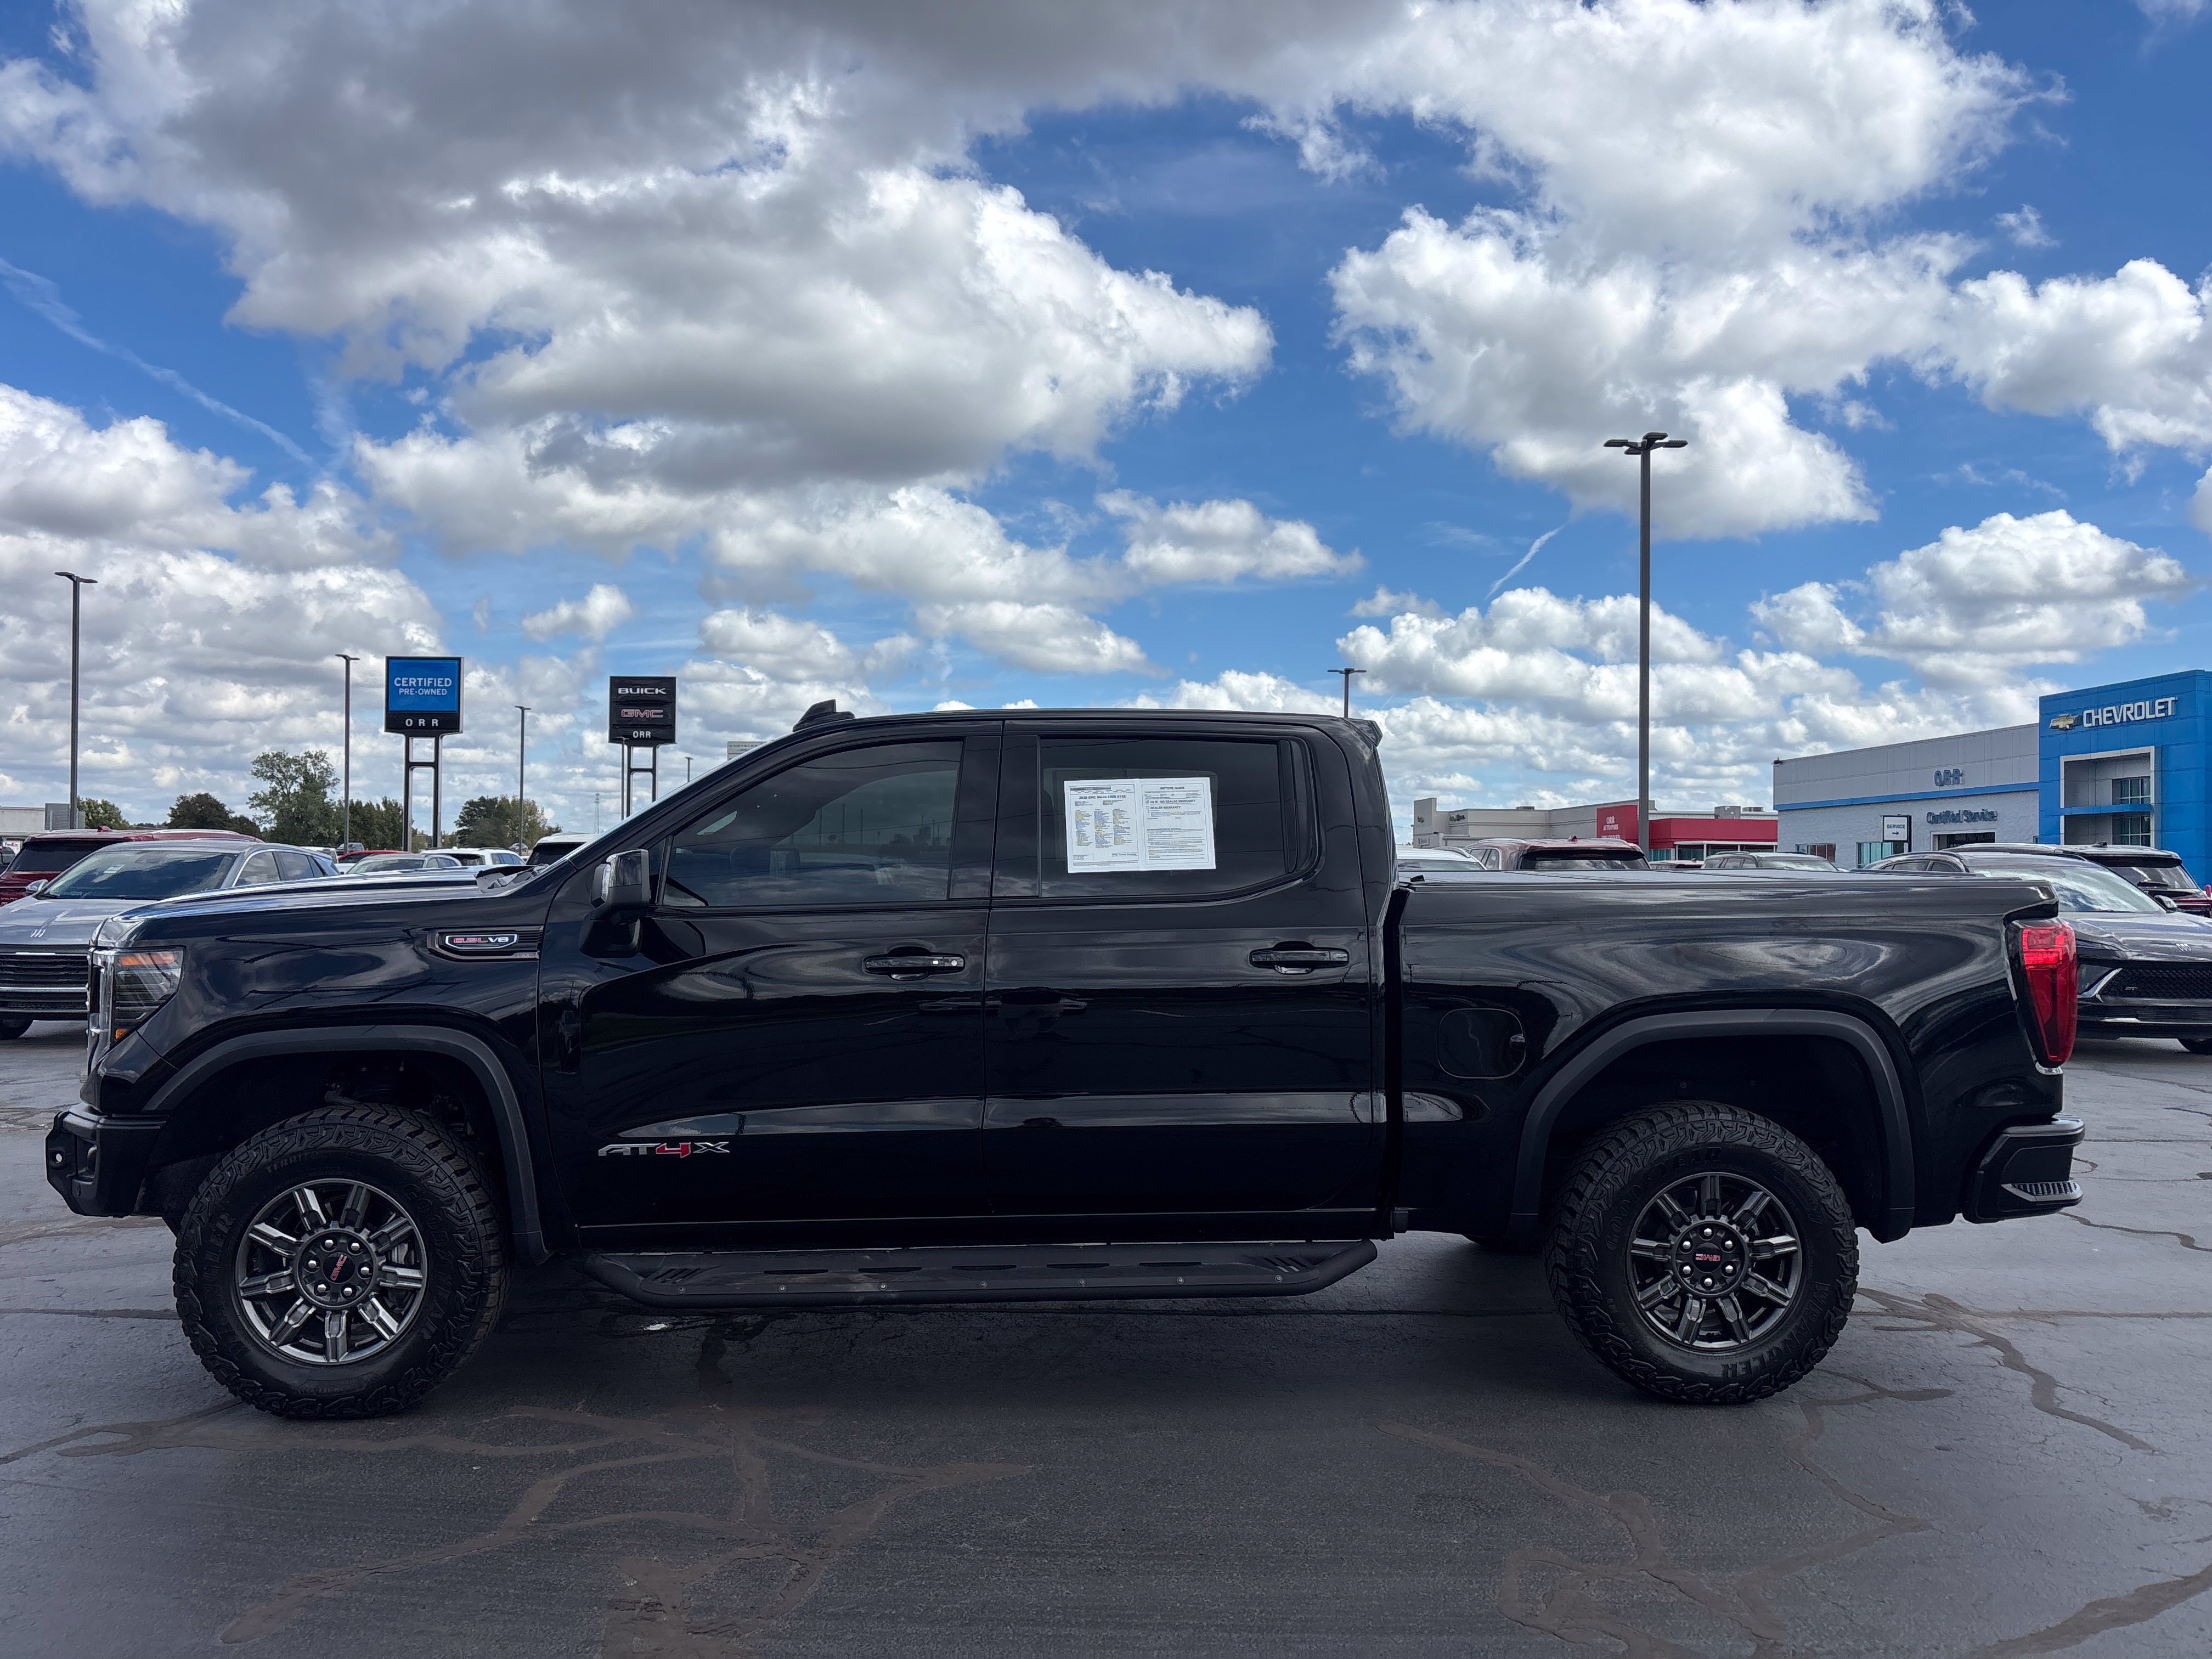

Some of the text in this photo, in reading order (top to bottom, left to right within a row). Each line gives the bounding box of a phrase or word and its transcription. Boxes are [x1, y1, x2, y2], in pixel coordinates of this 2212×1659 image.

[394, 677, 452, 687] CERTIFIED
[621, 709, 663, 718] GMC
[2083, 697, 2177, 727] CHEVROLET
[633, 730, 651, 738] ORR
[1934, 769, 1964, 787] ORR
[1606, 816, 1615, 824] ORR
[1926, 808, 1998, 824] Certified Service
[598, 1141, 730, 1159] AT4X
[1695, 1254, 1720, 1262] GMC
[330, 1254, 347, 1280] GMC
